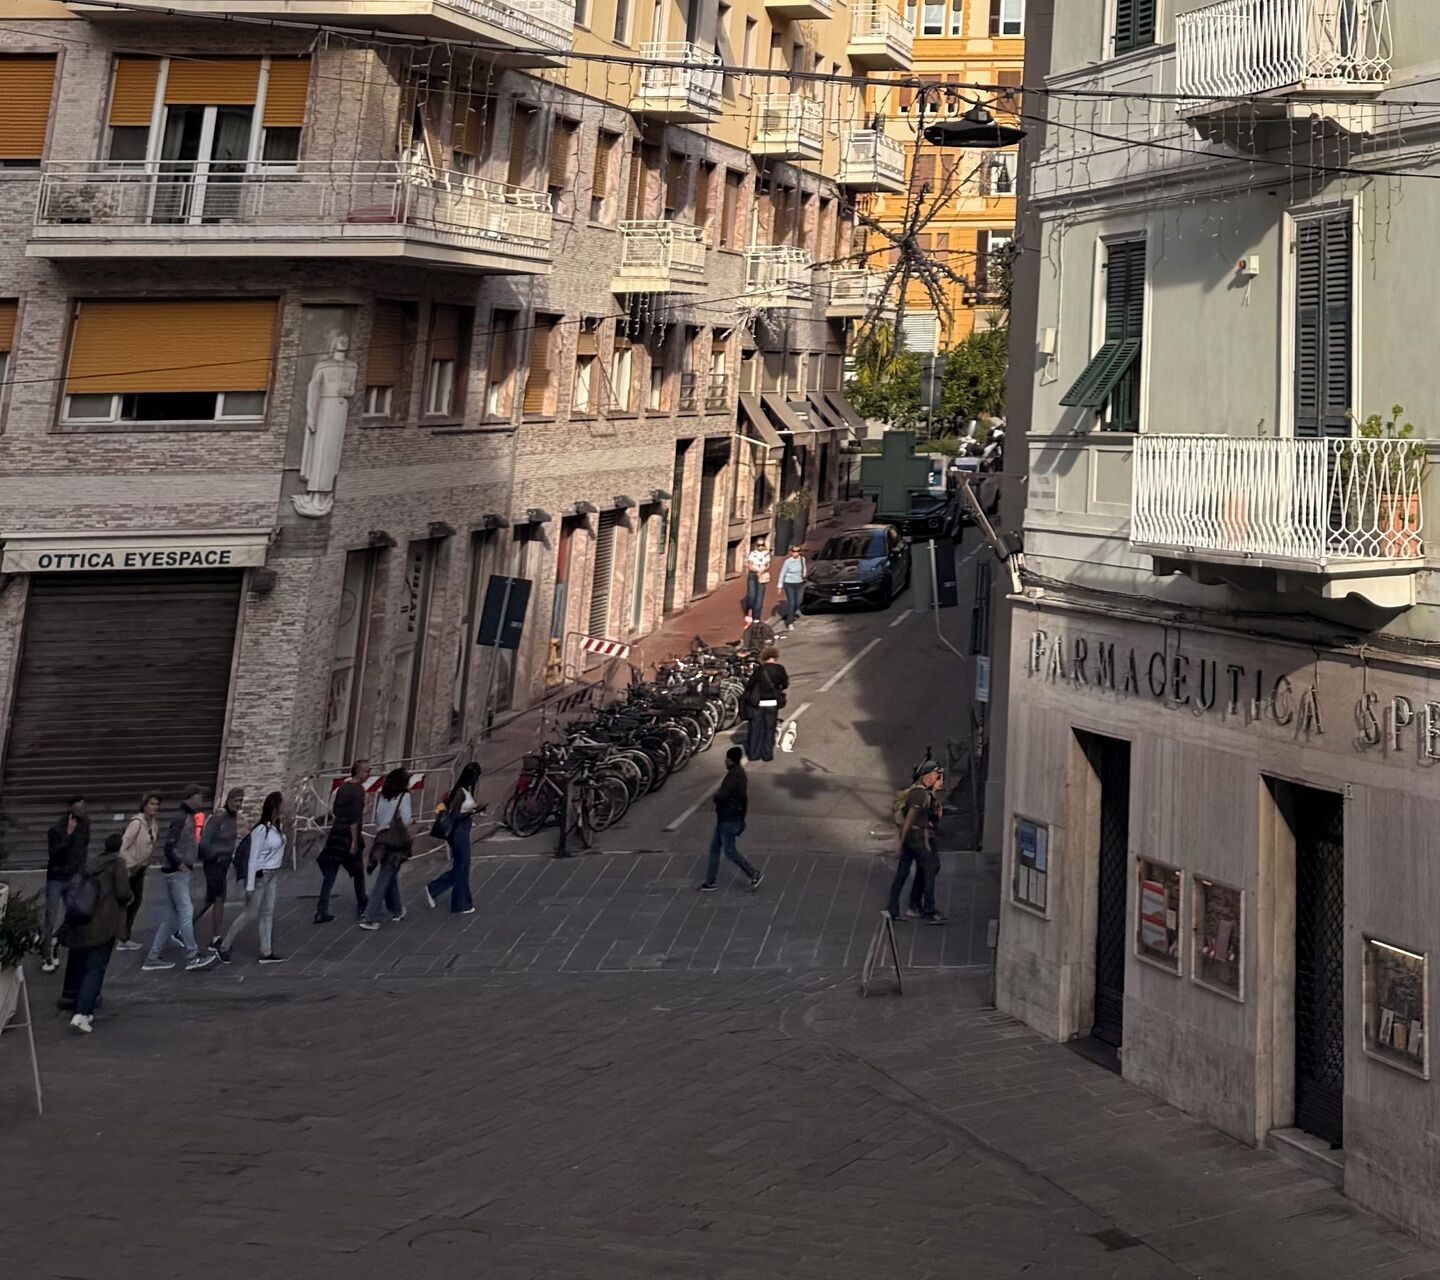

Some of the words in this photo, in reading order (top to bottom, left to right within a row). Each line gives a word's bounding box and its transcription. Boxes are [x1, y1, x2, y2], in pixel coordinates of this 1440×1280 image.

[38, 553, 115, 569] OTTICA
[123, 550, 232, 567] EYESPACE
[1029, 630, 1324, 735] FARMACEUTICA
